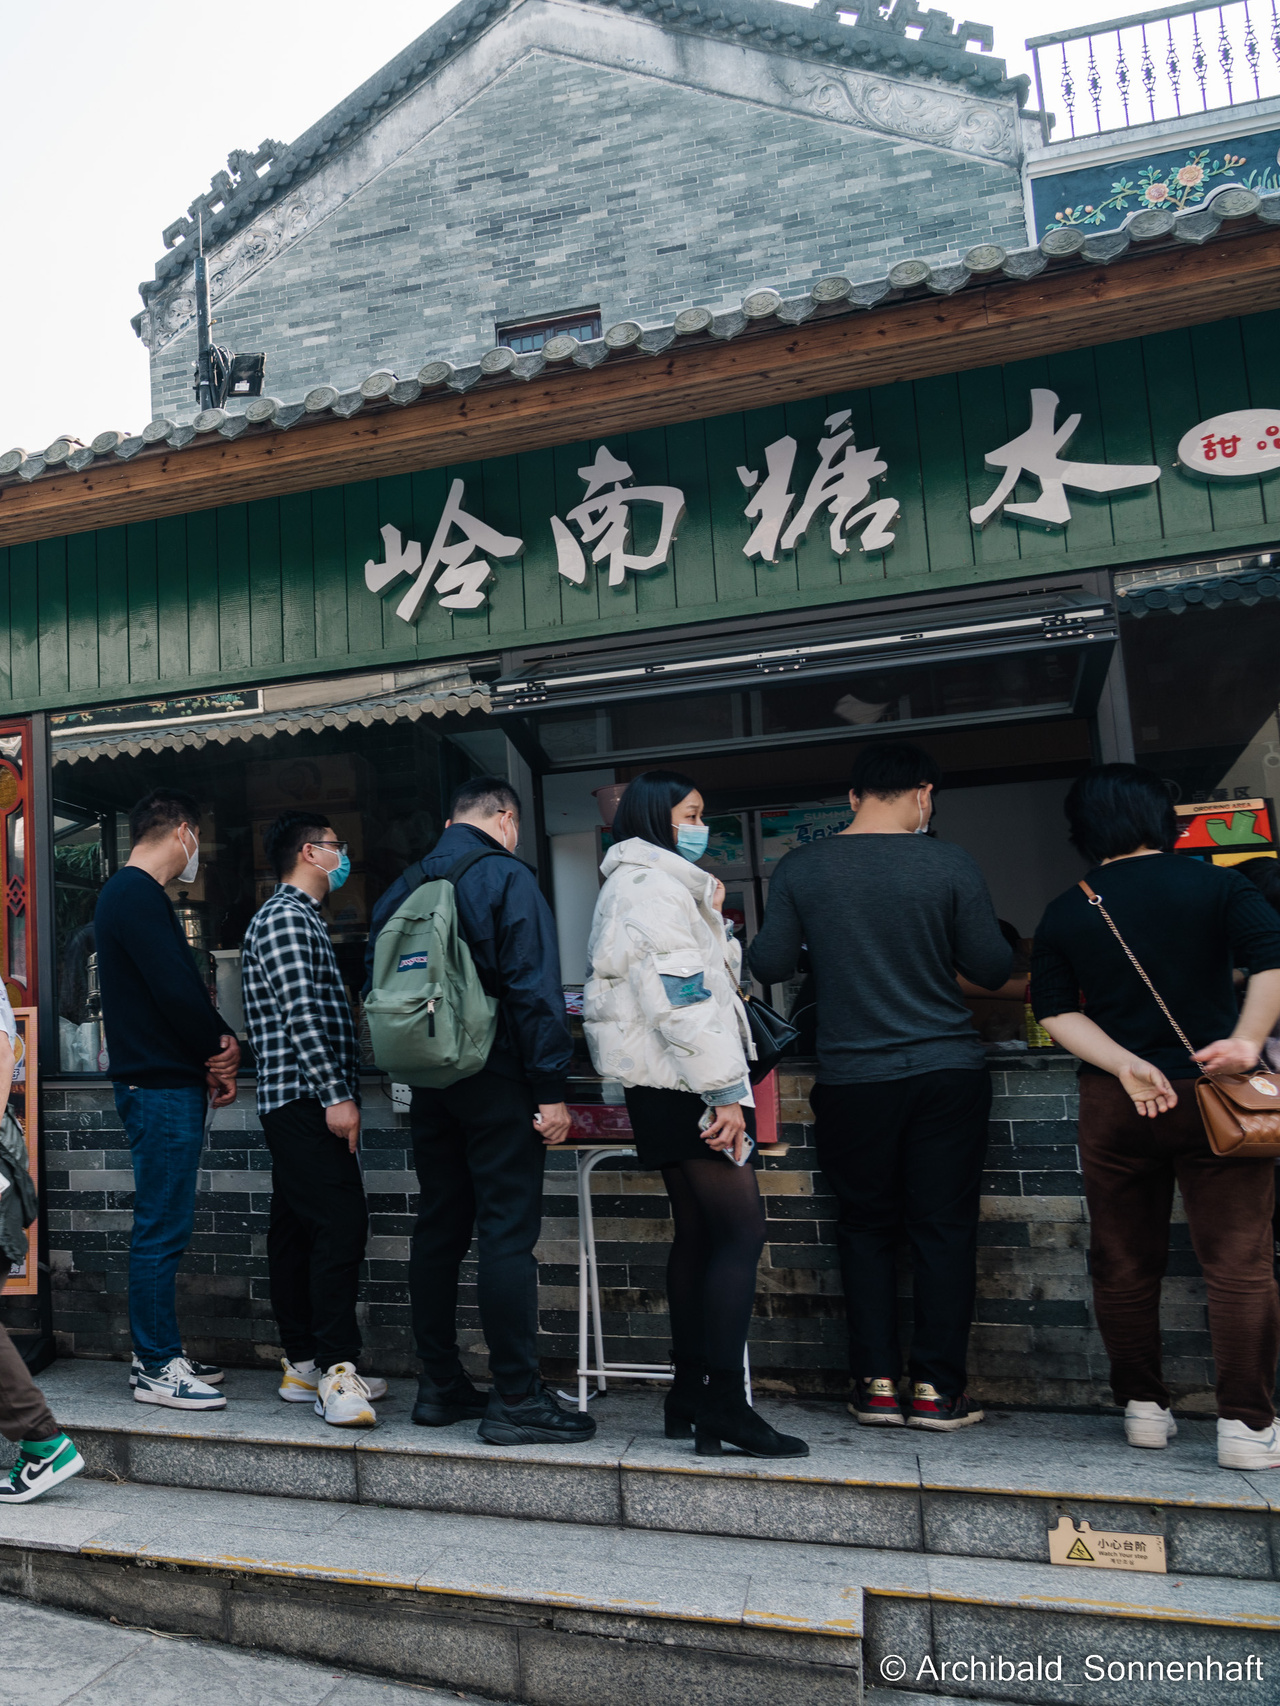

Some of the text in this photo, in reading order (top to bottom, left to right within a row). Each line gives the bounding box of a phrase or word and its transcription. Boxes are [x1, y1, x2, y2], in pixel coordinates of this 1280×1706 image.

[364, 388, 1163, 625] 岭南糖水
[1193, 804, 1231, 812] ORDERING
[803, 810, 854, 821] SUMME
[1097, 1538, 1147, 1552] 小心台阶
